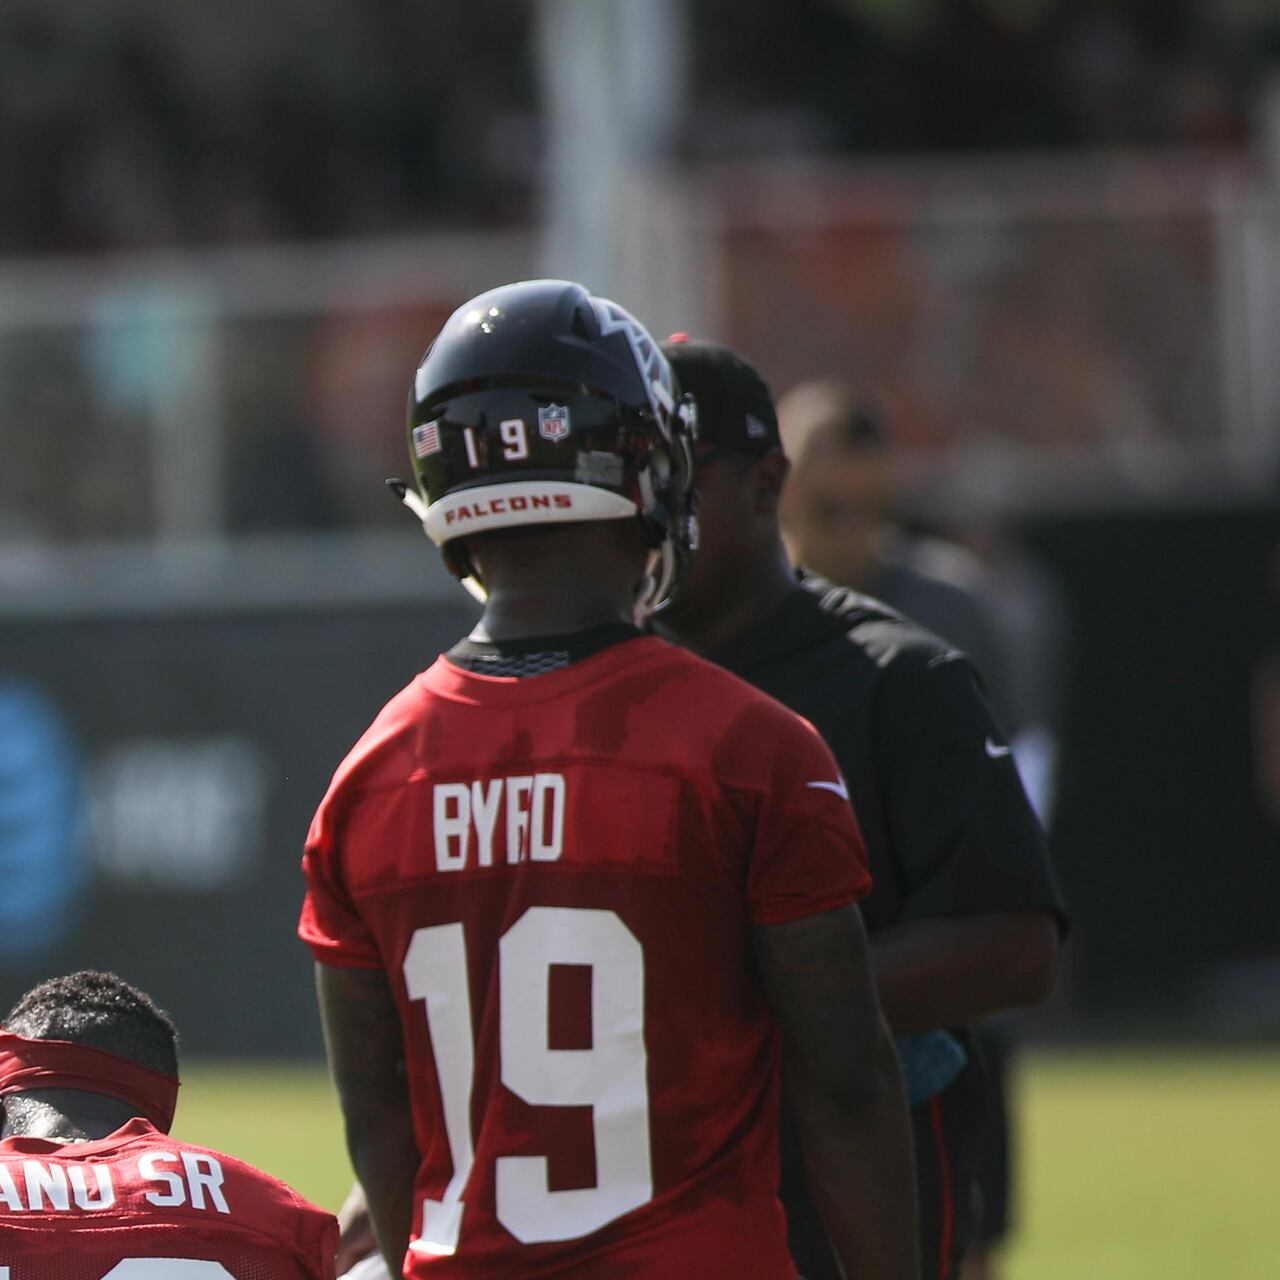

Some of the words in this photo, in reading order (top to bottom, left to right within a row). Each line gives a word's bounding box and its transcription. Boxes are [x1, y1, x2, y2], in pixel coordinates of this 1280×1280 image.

[463, 418, 529, 468] 19
[444, 494, 573, 525] FALCONS
[402, 906, 654, 1256] 19
[137, 1151, 231, 1215] SR
